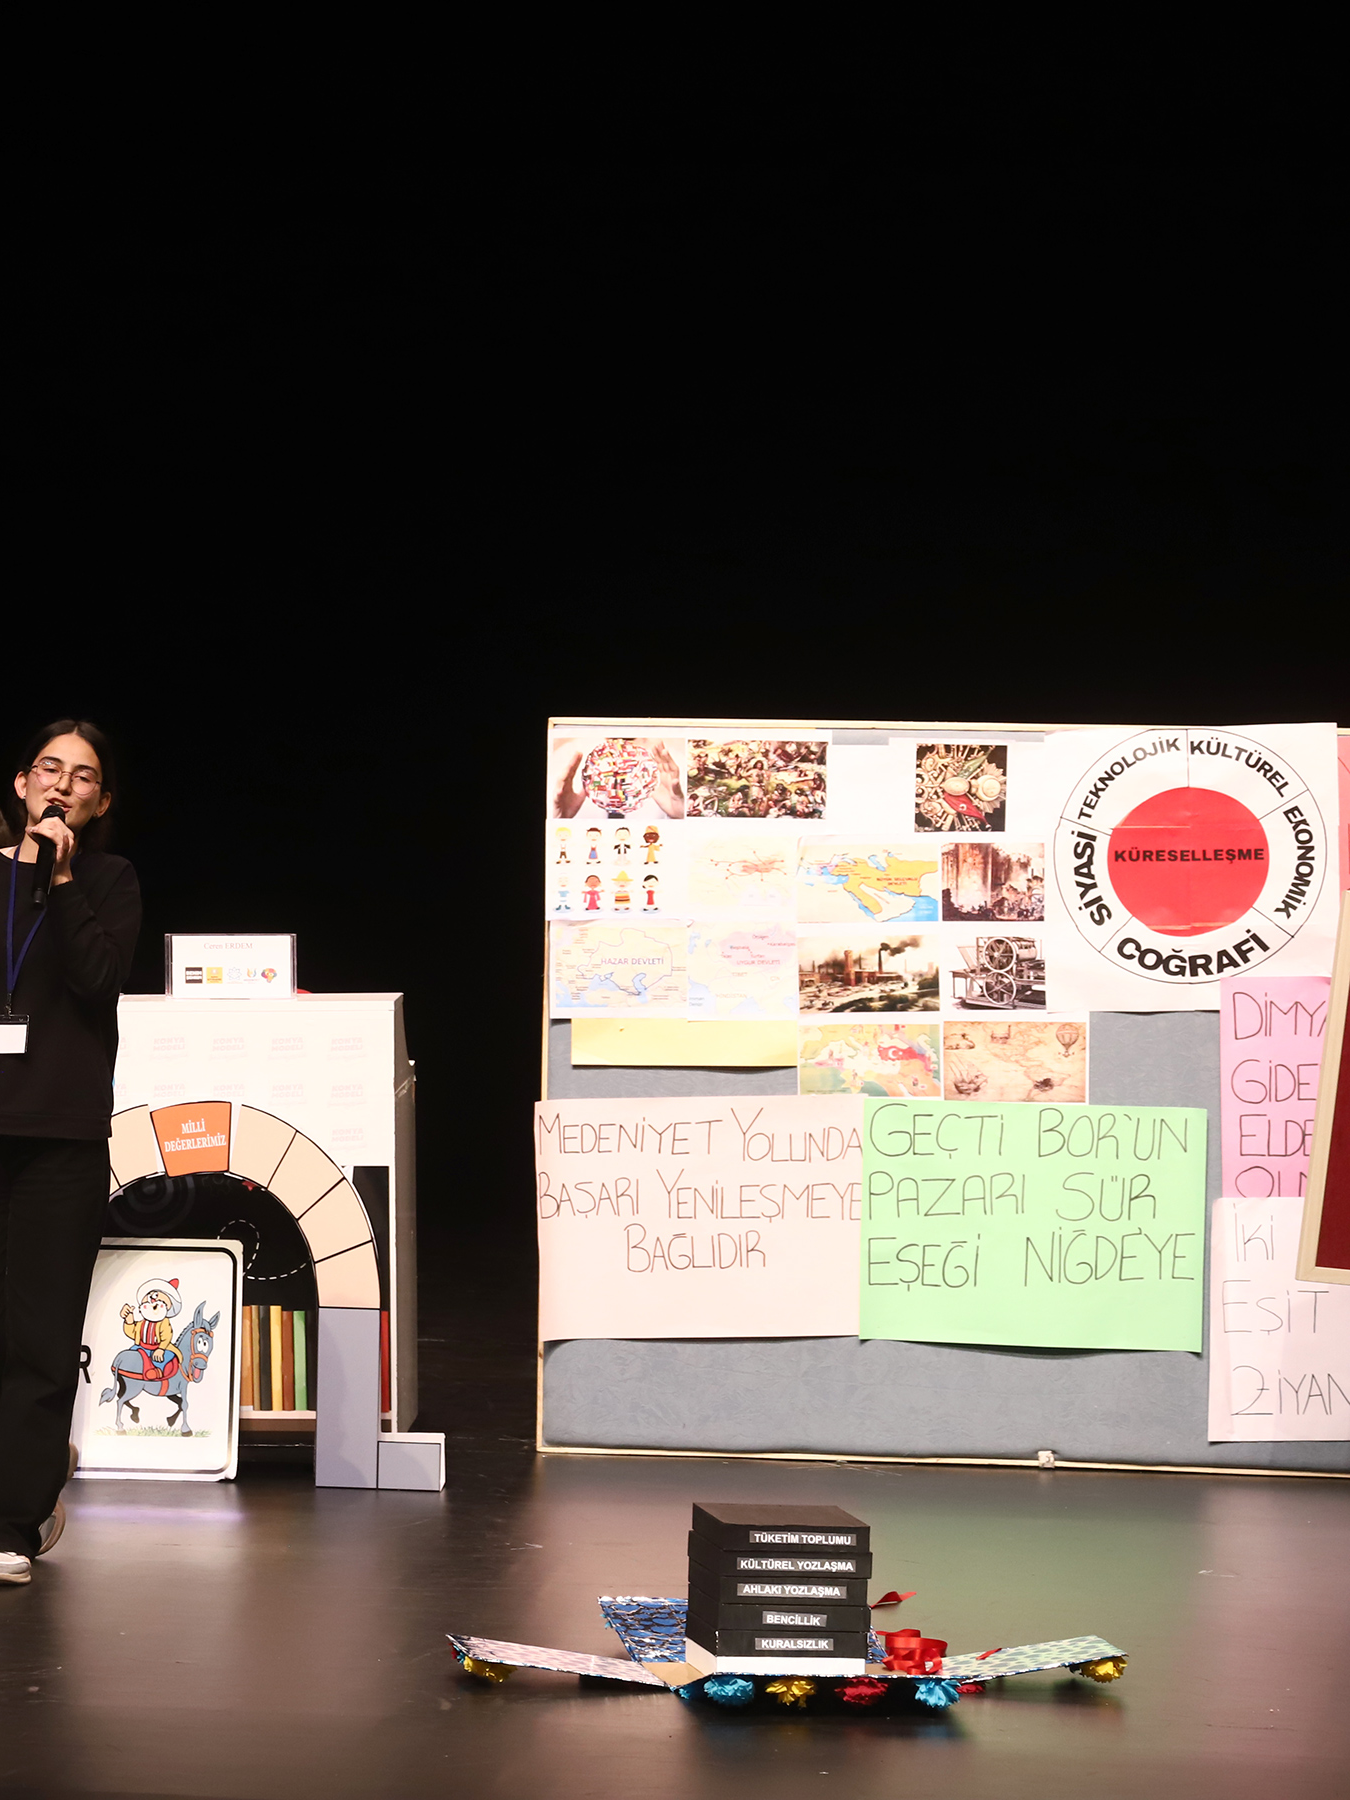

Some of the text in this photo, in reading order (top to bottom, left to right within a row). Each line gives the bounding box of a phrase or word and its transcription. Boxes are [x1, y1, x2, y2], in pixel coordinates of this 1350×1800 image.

[1078, 737, 1315, 919] TEKNOLOJİK KÜLTÜREL EKONOMİK
[1071, 830, 1112, 926] SİYASİ
[1114, 847, 1264, 864] KÜRESELLEŞME
[632, 957, 664, 965] DEVLETİ
[1116, 928, 1270, 977] COĞRAFİ
[1231, 1059, 1318, 1104] GİDE
[164, 1132, 226, 1152] DEĞERLERİMİZ
[181, 1118, 206, 1134] MİLLİ
[539, 1108, 863, 1162] MEDENİYET YOLUNDA
[870, 1103, 1004, 1159] GEÇTİ
[538, 1171, 639, 1219] BAŞARI
[869, 1170, 1156, 1222] PAZARI SÜR
[624, 1223, 766, 1273] BAĞLIDIR
[1233, 1203, 1274, 1262] İKİ
[868, 1233, 980, 1292] EŞEĞİ
[754, 1533, 851, 1545] TÜKETİM TOPLUMU
[740, 1559, 853, 1572] KÜLTÜREL YOZLAŞMA
[784, 1585, 840, 1597] YOZLAŞMA
[766, 1614, 820, 1626] BENCİLLİK
[762, 1640, 828, 1649] KURALSIZLIK
